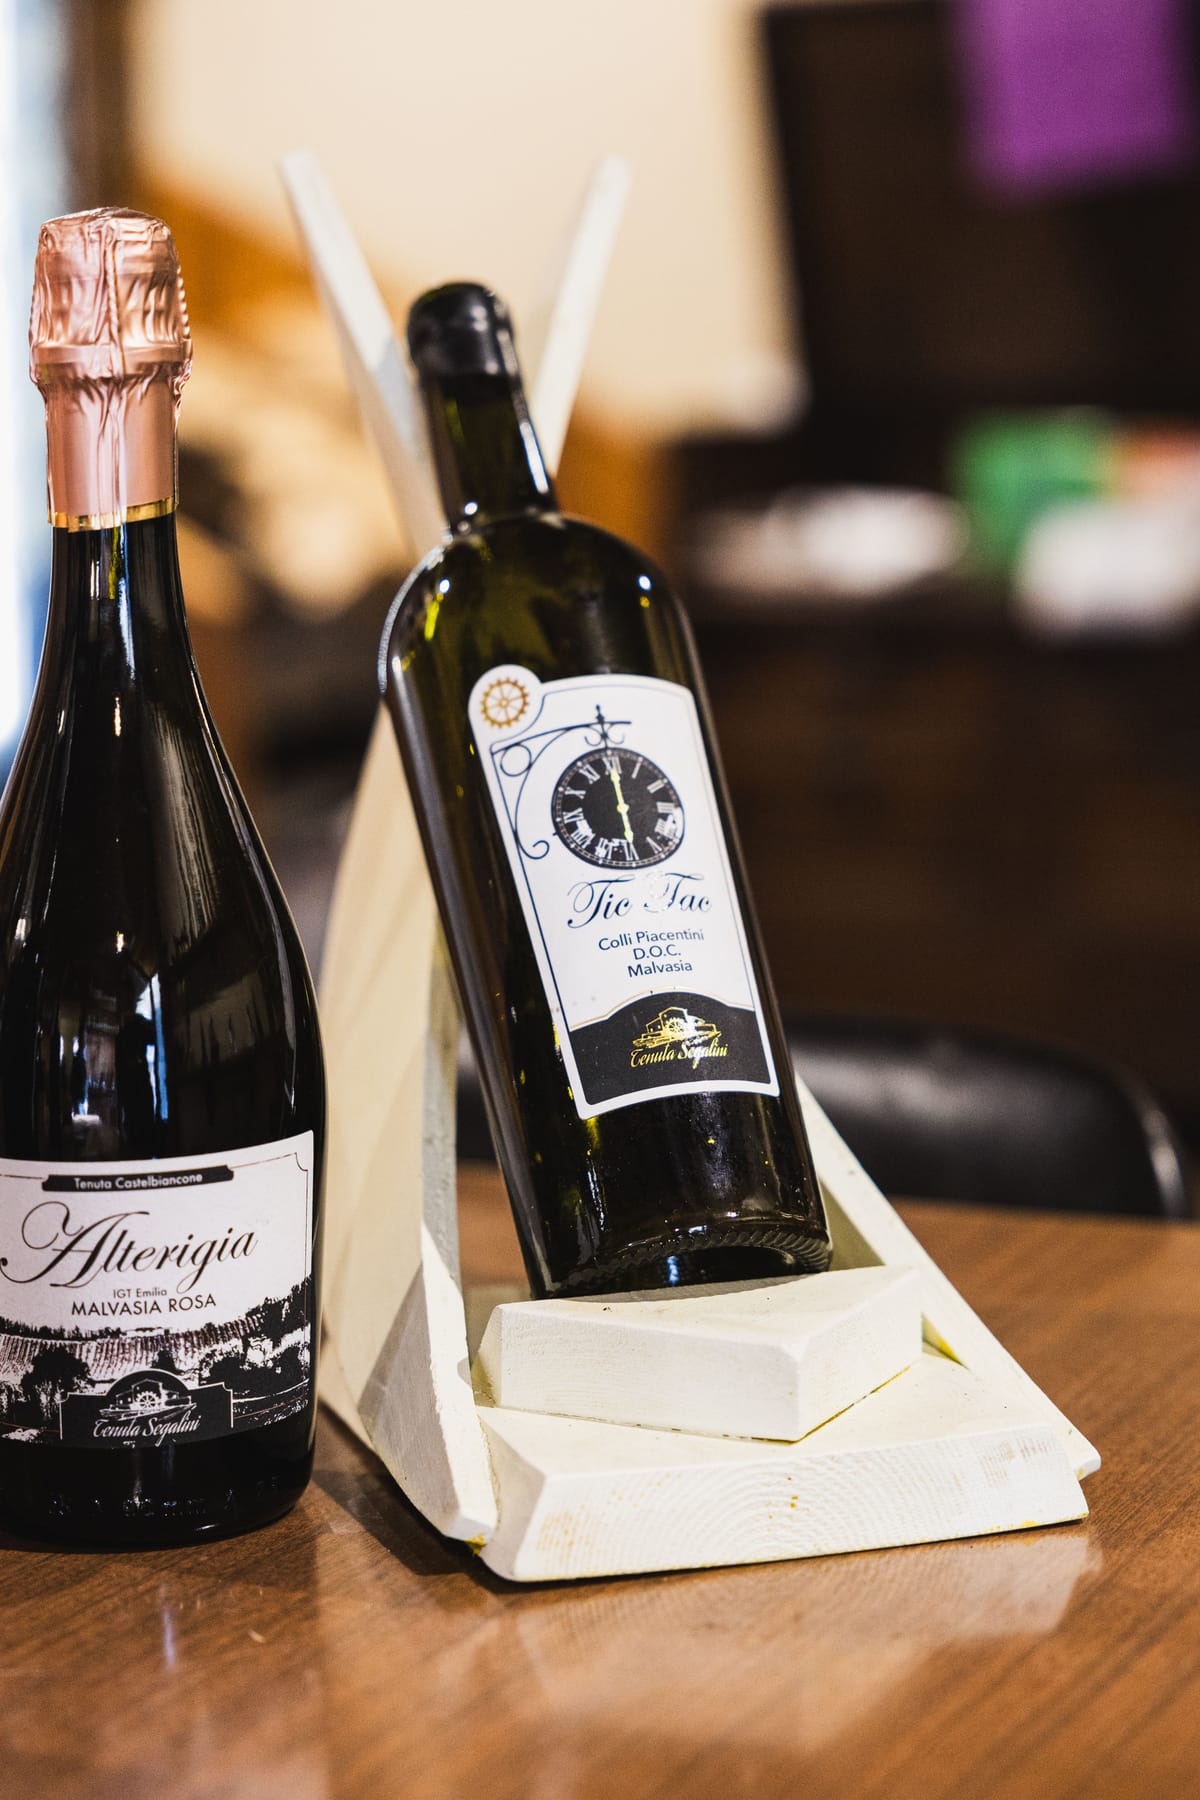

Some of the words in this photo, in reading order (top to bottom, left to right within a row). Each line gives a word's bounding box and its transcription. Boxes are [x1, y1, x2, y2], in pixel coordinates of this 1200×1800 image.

[567, 874, 635, 929] Tic
[643, 872, 712, 914] Tac
[598, 933, 633, 951] Colli
[636, 928, 705, 944] Piacentini
[633, 944, 682, 960] D.O.C.
[627, 960, 693, 978] Malvasia
[630, 1042, 675, 1068] Tenuta
[74, 1177, 113, 1190] Tenuta
[115, 1173, 204, 1190] Castelbiancone
[0, 1200, 260, 1295] Alterigia
[113, 1288, 132, 1299] IGT
[135, 1286, 168, 1299] Emilia
[71, 1299, 162, 1317] MALVASIA
[168, 1293, 217, 1313] ROSA
[93, 1418, 141, 1438] Tenuta
[142, 1409, 202, 1448] Segalini
